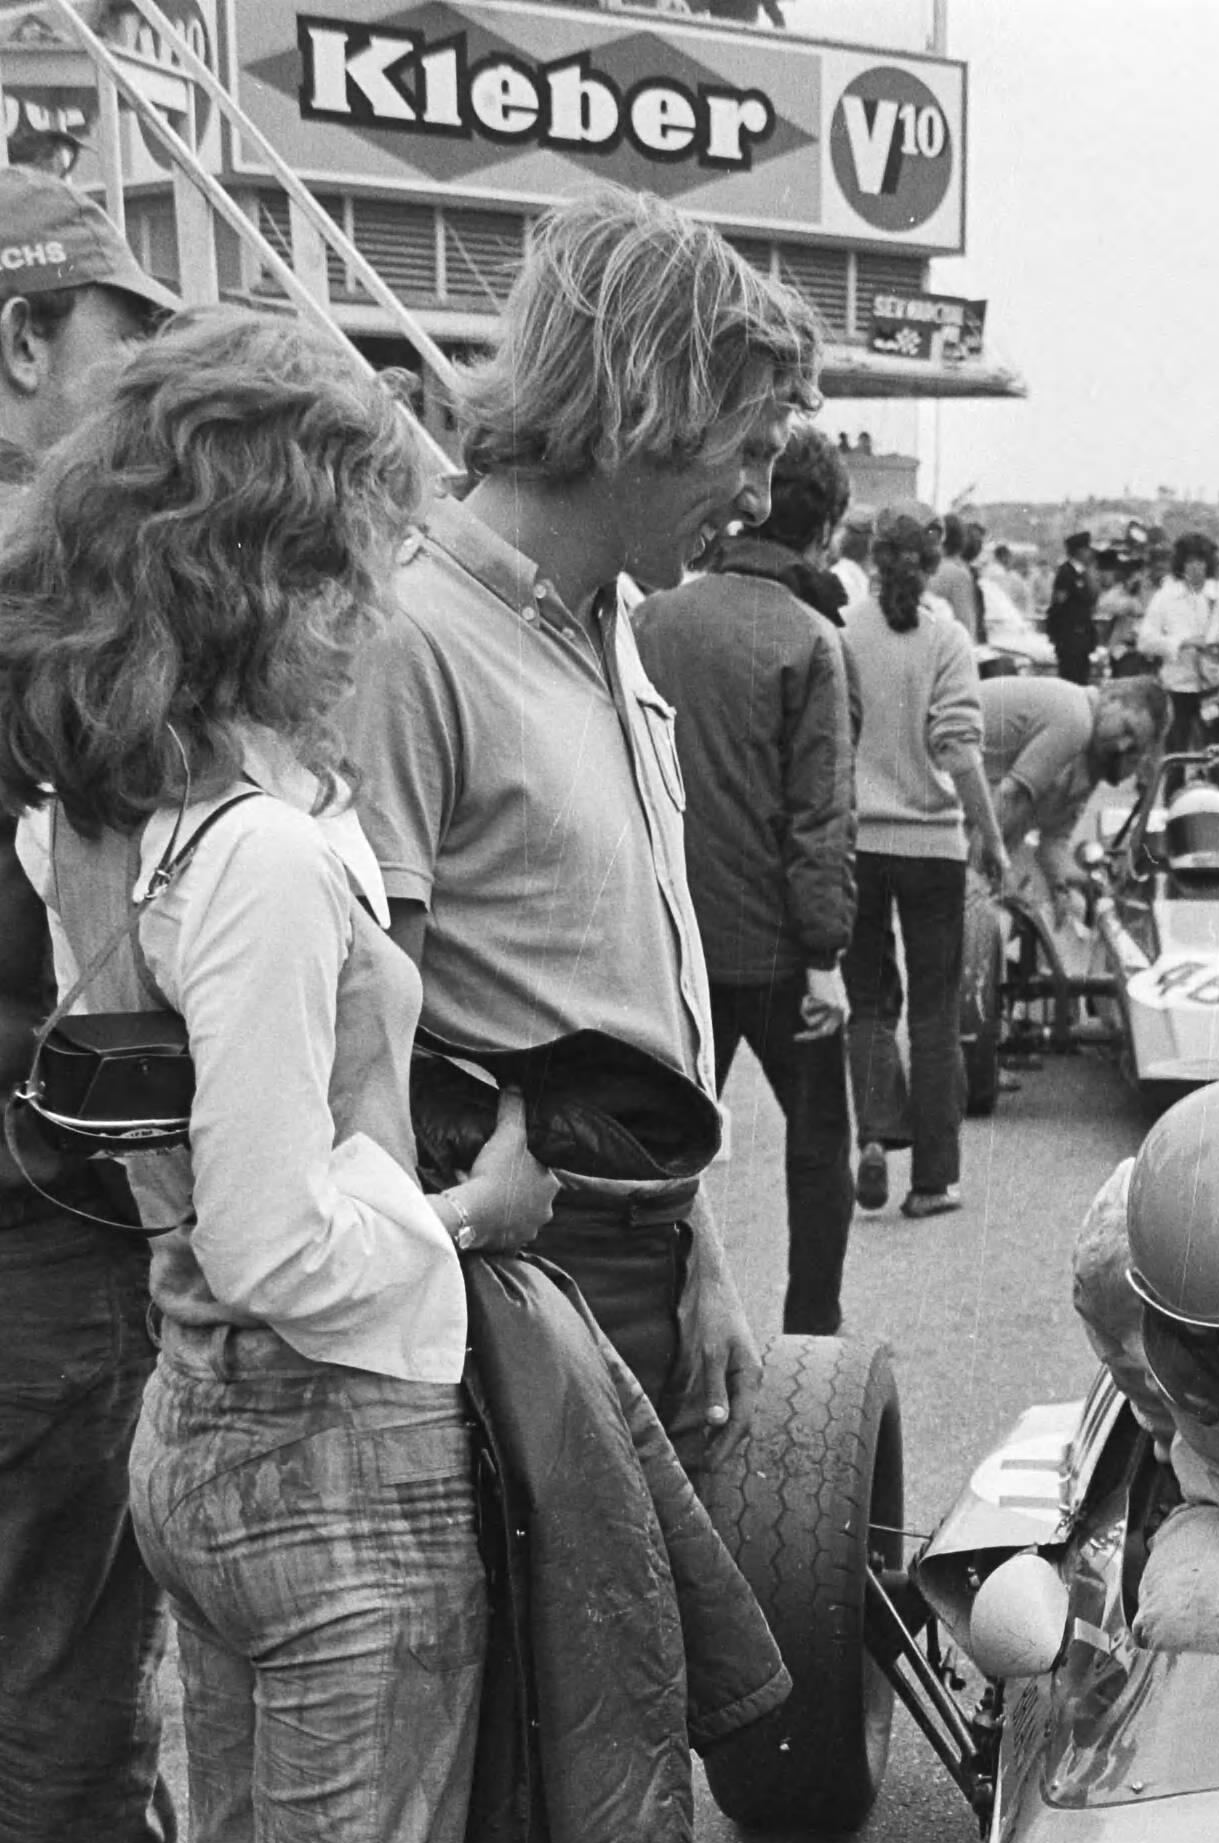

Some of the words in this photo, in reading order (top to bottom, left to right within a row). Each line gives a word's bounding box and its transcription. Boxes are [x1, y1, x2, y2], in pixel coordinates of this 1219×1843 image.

[303, 27, 768, 160] Kleber
[843, 96, 945, 195] V10
[0, 241, 66, 270] CHS
